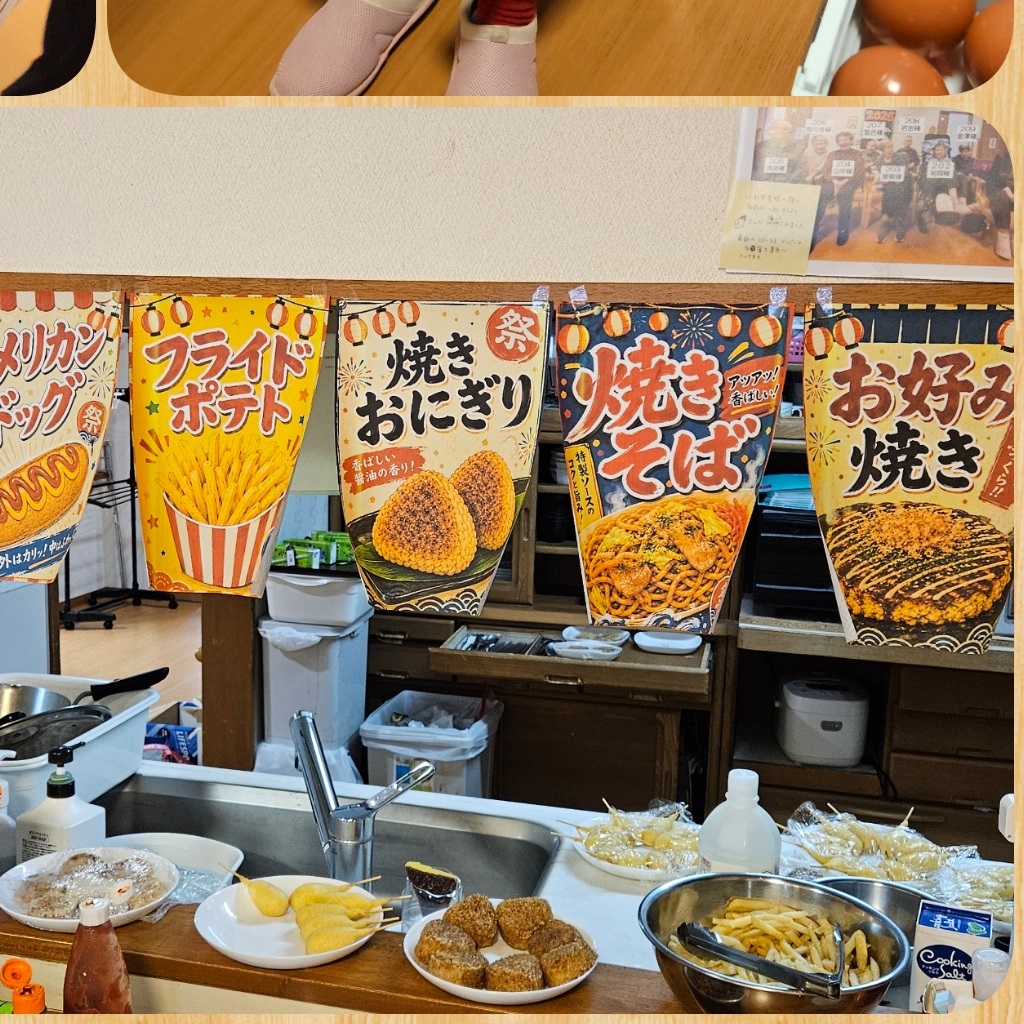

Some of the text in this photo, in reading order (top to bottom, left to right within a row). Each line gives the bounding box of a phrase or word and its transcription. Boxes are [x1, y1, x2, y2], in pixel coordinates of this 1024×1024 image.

[145, 329, 314, 392] フライド
[387, 330, 476, 391] 焼き
[494, 309, 541, 353] 祭
[169, 379, 292, 436] ポテト
[355, 374, 533, 446] おにぎり
[566, 334, 723, 442] 焼き
[730, 384, 779, 407] 香ばしい!
[830, 350, 1014, 425] お好み
[81, 404, 101, 433] 祭
[352, 454, 396, 471] 香ばしい
[576, 451, 595, 515] 特製ソースの
[599, 415, 761, 498] そば
[844, 421, 984, 494] 焼き
[920, 950, 973, 975] Cooking
[937, 963, 967, 981] Salt
